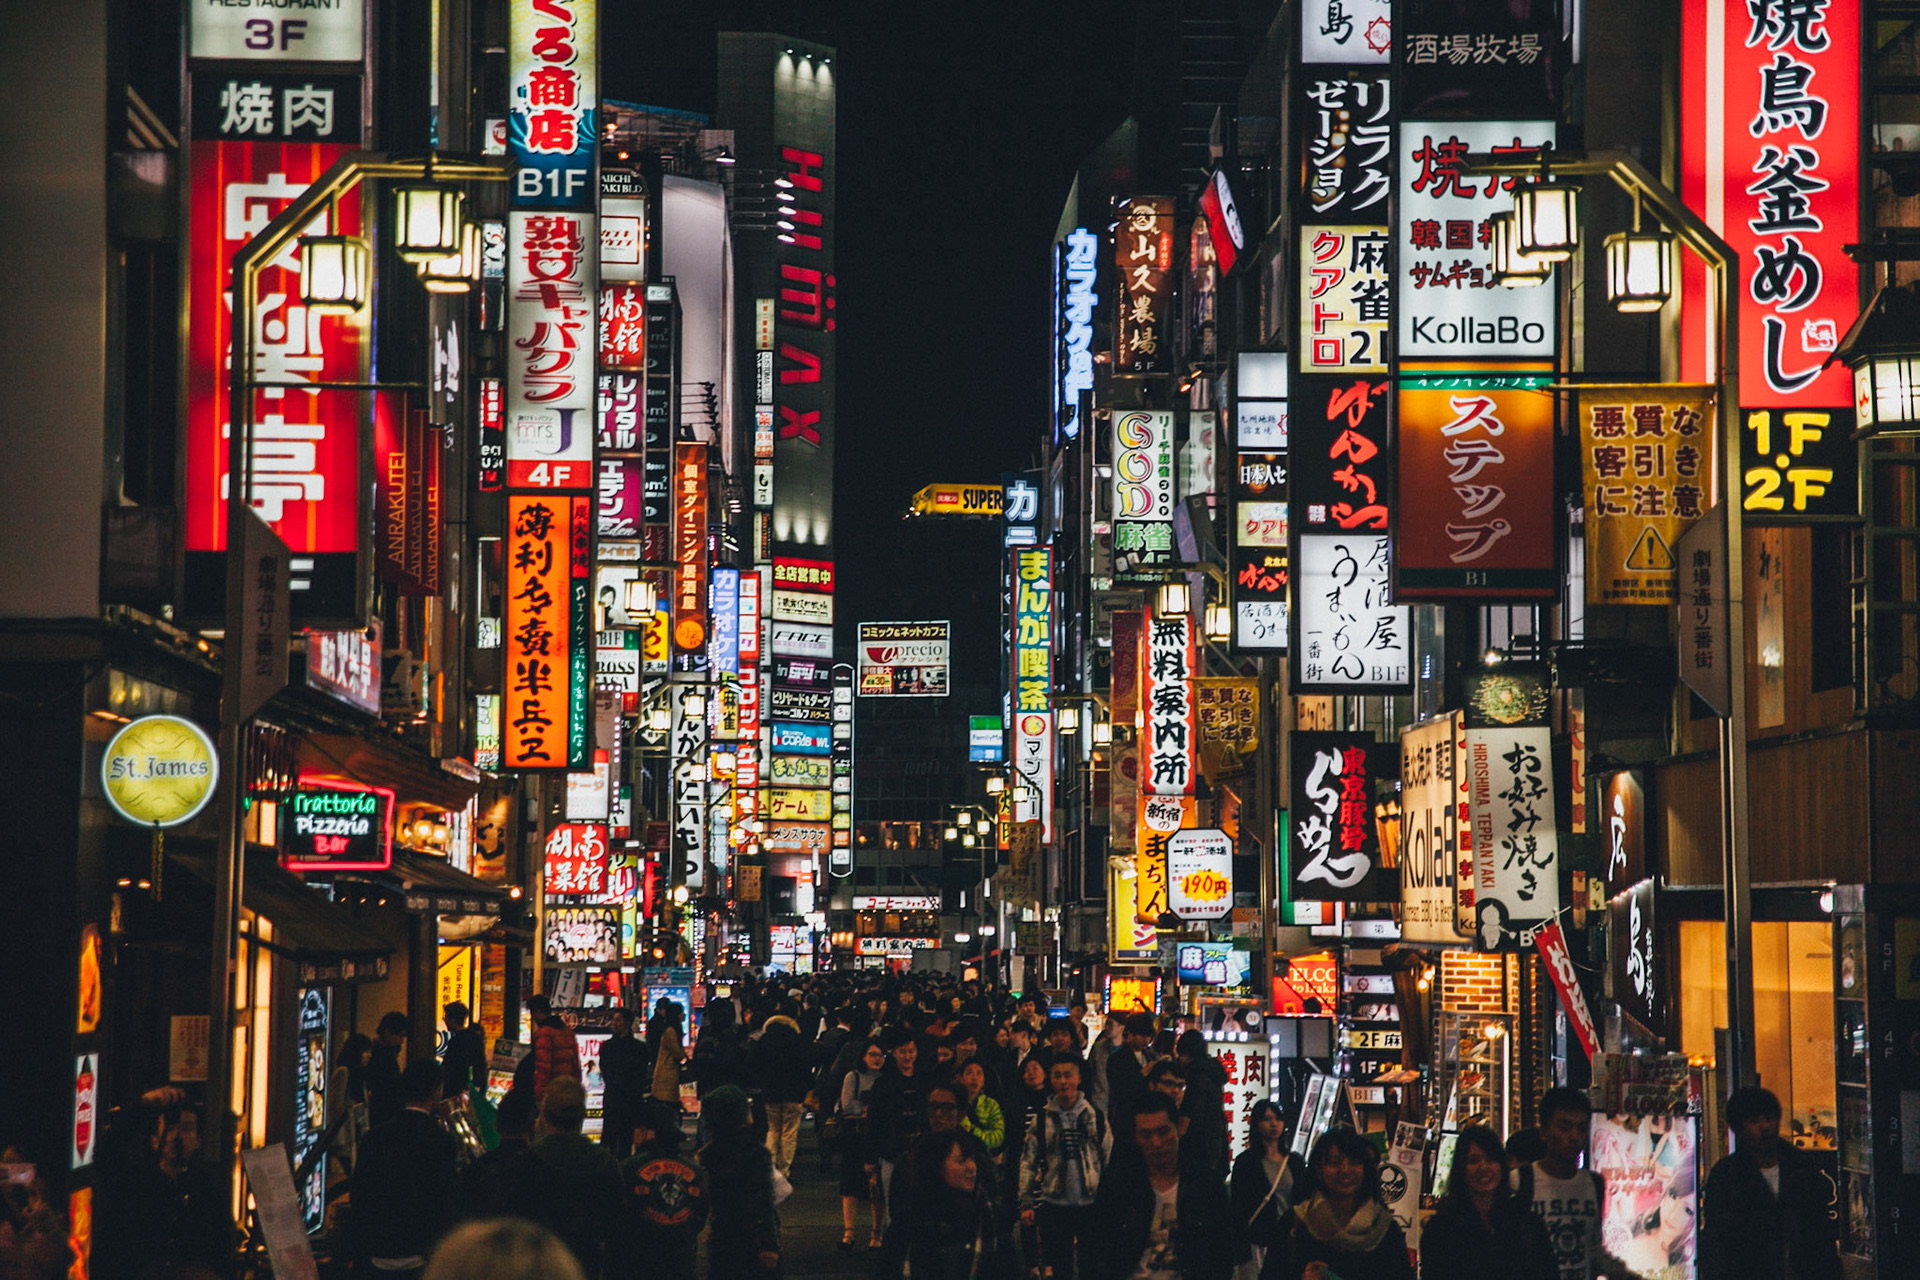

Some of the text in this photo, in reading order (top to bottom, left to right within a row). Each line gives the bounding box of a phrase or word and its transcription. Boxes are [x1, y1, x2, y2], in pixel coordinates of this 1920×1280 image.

[245, 19, 307, 50] 3F
[1405, 33, 1542, 65] 酒場牧場
[219, 81, 334, 136] 焼肉
[1305, 79, 1347, 213] ゼーション
[1351, 79, 1391, 211] リラク
[517, 168, 587, 197] B1F
[1745, 0, 1831, 392] 焼鳥釜めし
[514, 215, 588, 402] 熟女キャバクラ
[1311, 231, 1344, 366] クアトロ
[1412, 316, 1546, 344] KollaBo
[604, 353, 625, 365] 4F
[616, 376, 637, 449] レンタル
[1593, 404, 1701, 438] 悪質な
[1158, 416, 1170, 478] リーチ麻雀
[1748, 411, 1830, 455] 1F
[529, 463, 571, 486] 4F
[1117, 412, 1154, 517] GOD
[1240, 463, 1288, 487] 日本人セ
[1593, 444, 1701, 477] 客引き
[599, 461, 625, 516] エデン
[1441, 395, 1511, 563] ステップ
[1743, 467, 1834, 511] 2F
[388, 451, 404, 564] ANRAKUTEI
[963, 489, 1002, 509] SUPER
[1594, 484, 1702, 518] に注意
[425, 486, 439, 591] ANRAKUTEI
[683, 464, 697, 610] 個室ダイニング居酒屋
[1115, 522, 1172, 552] 麻雀
[775, 564, 831, 584] 全店営業中
[1465, 571, 1488, 586] B1
[716, 571, 737, 651] カラオケ
[1326, 544, 1364, 680] うまいもん
[1692, 548, 1714, 669] 劇場通り一番街
[600, 632, 622, 645] B1F
[1018, 551, 1049, 711] まんが喫茶
[1305, 630, 1324, 681] 一番街
[1372, 665, 1407, 682] B1F
[1153, 622, 1187, 785] 無料案内所
[1200, 688, 1252, 703] 悪質な
[1201, 708, 1252, 723] 客引き
[1203, 726, 1254, 742] に注意
[144, 756, 208, 778] James
[772, 798, 808, 815] ゲーム
[1147, 802, 1181, 822] 新宿
[1339, 746, 1367, 851] 東京豚骨
[296, 816, 369, 836] Pizzeria
[1158, 821, 1171, 831] の
[1473, 743, 1496, 888] HIROSHIMA TEPPANYAKI
[1499, 742, 1554, 901] お好み焼き
[315, 836, 350, 854] Bar
[774, 828, 826, 841] メンズサウナ
[1184, 875, 1227, 894] 190円
[867, 898, 903, 909] コーヒー
[1360, 1033, 1379, 1047] 2F
[1360, 1060, 1377, 1074] 1F
